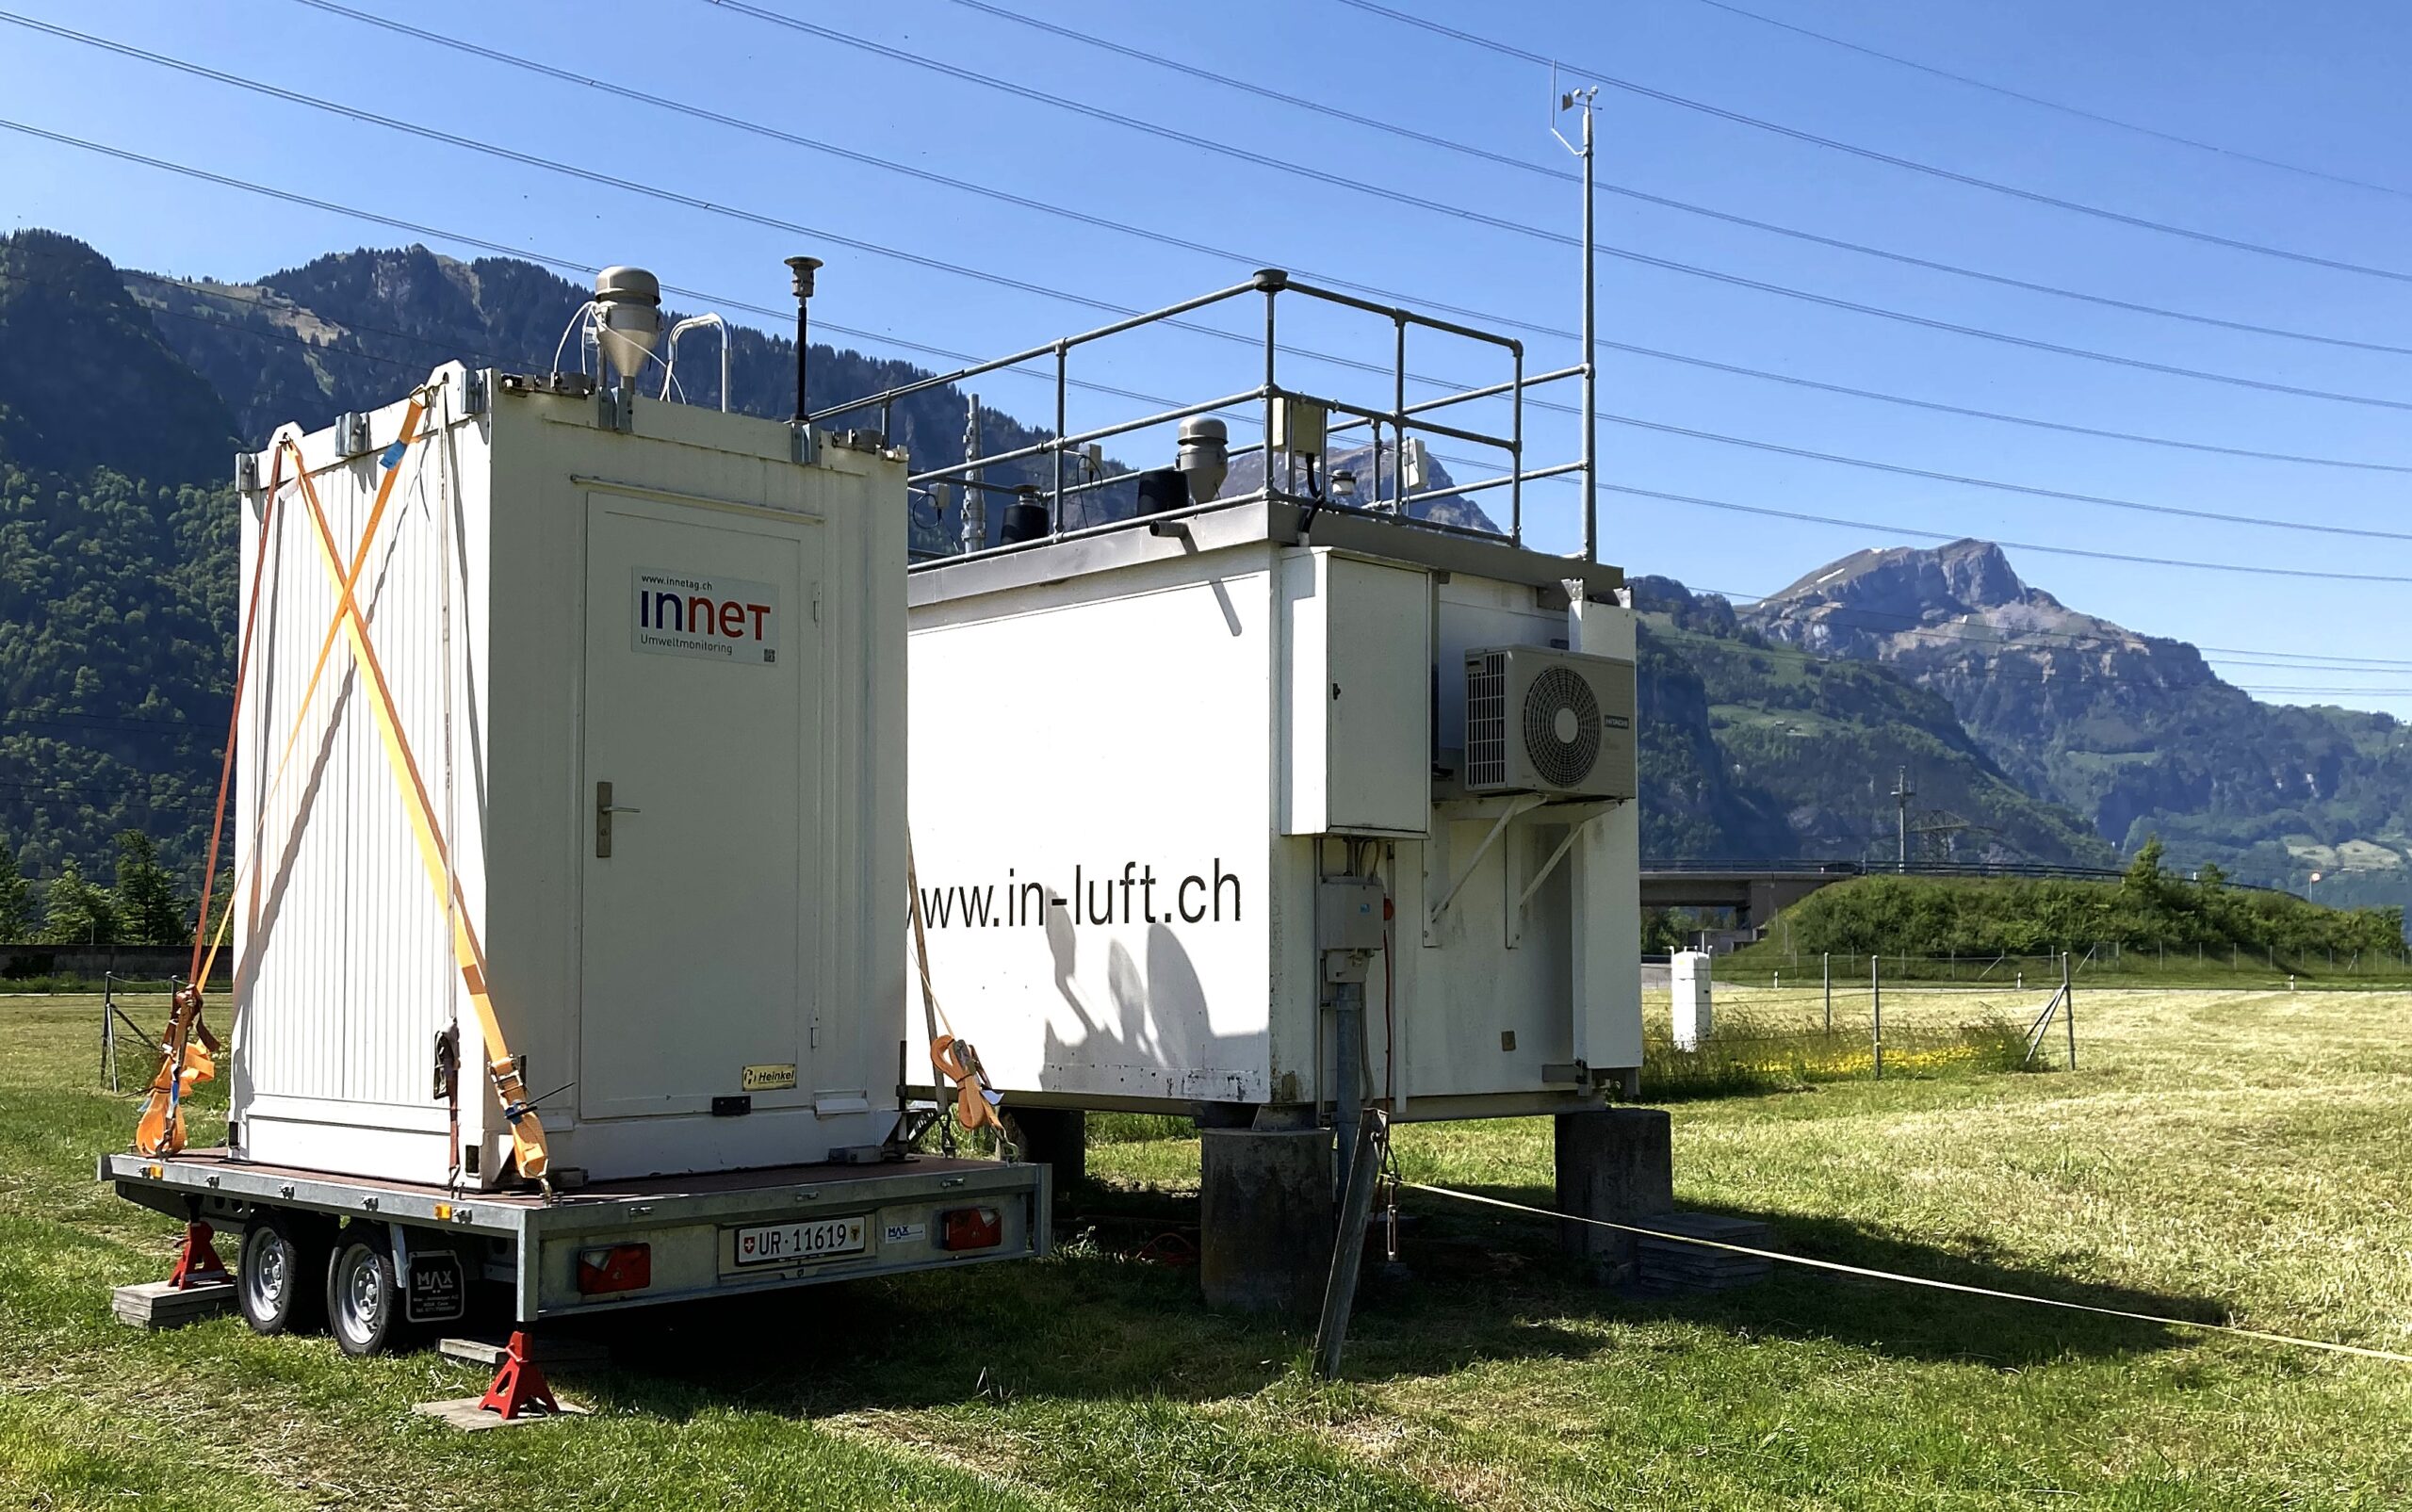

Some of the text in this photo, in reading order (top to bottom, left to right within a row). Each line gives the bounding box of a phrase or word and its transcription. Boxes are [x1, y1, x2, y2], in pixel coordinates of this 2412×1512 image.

[641, 575, 713, 592] www.innetag.ch
[641, 634, 733, 656] Umweltmonitoring
[907, 858, 1240, 929] ww.in-luft.ch
[758, 1069, 795, 1082] Heinkel
[888, 1225, 909, 1238] MAX
[416, 1270, 453, 1289] MAX
